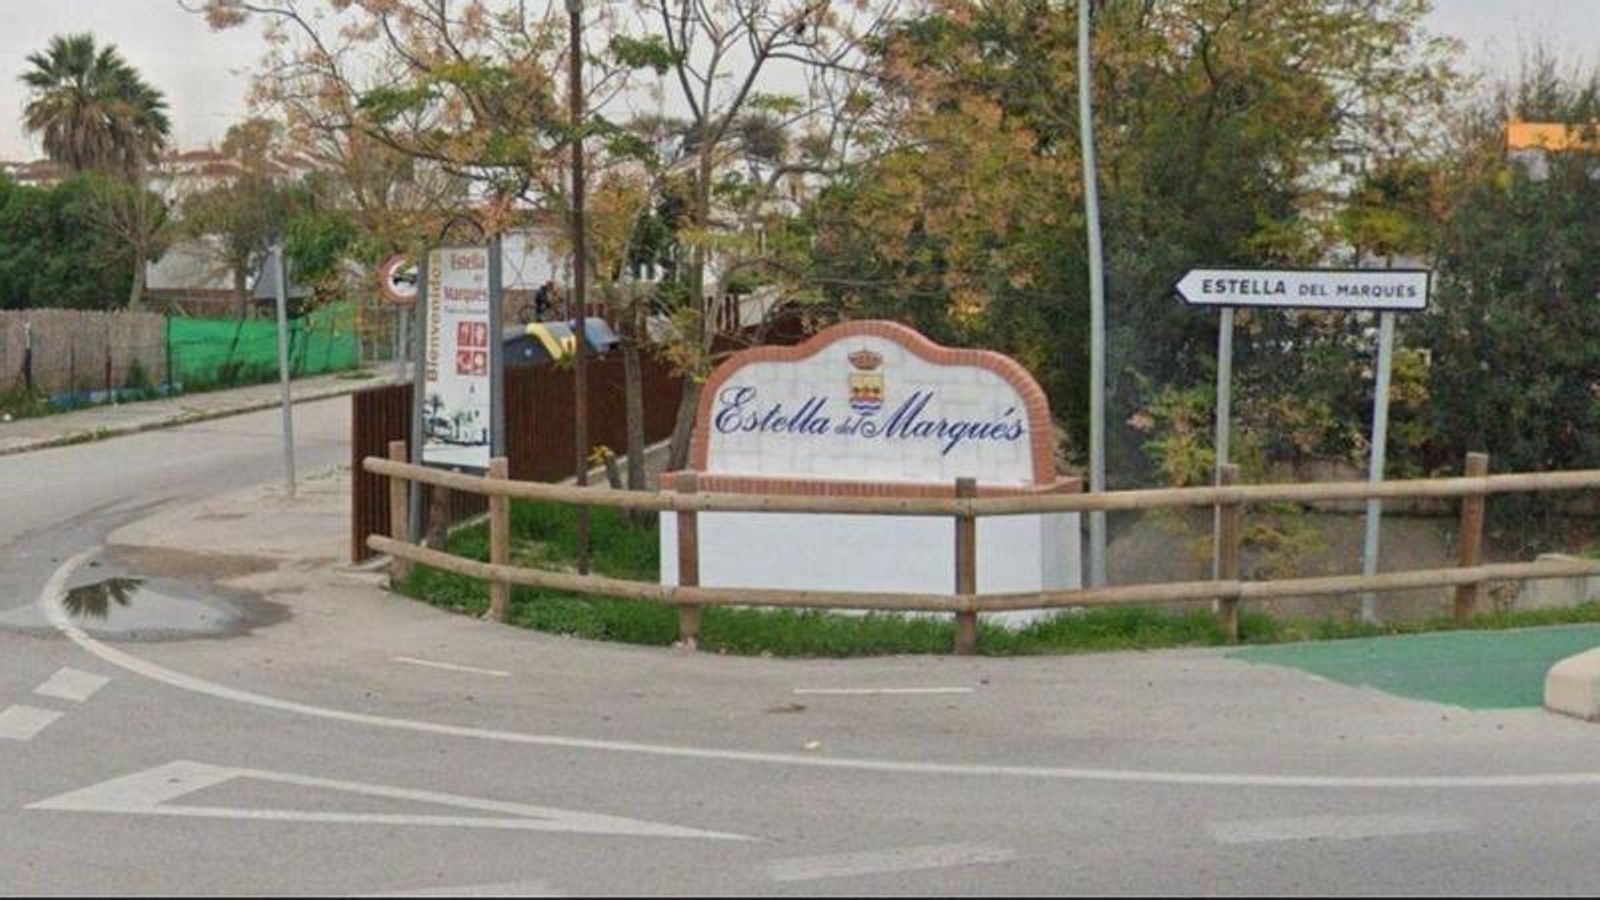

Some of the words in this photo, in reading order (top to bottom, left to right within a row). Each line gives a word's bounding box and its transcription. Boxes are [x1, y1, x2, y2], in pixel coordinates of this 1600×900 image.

[1202, 279, 1286, 296] ESTELLA
[1300, 284, 1329, 298] DEL
[715, 387, 829, 434] Estella
[834, 415, 864, 435] del
[860, 391, 1023, 455] Marqués
